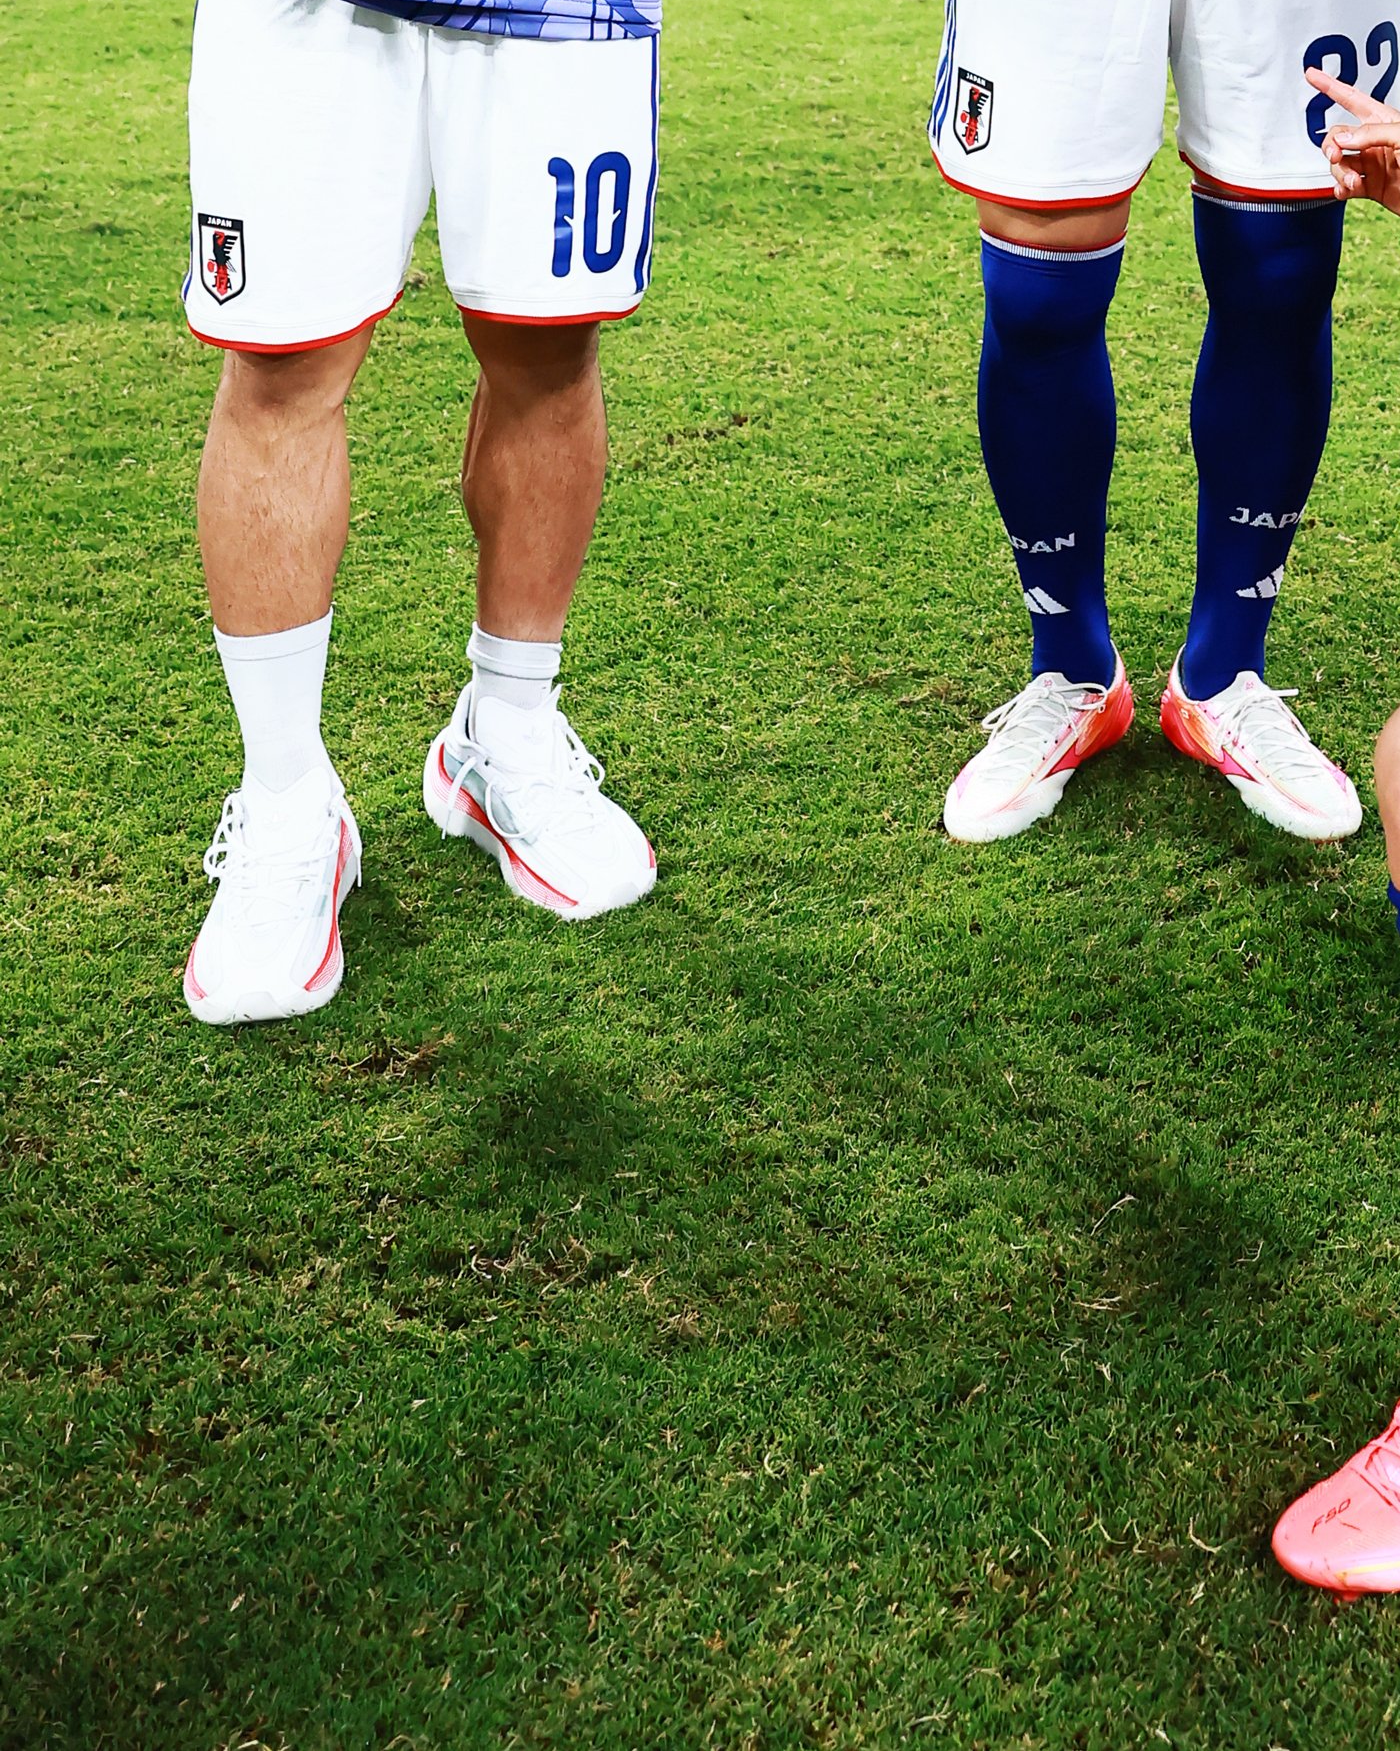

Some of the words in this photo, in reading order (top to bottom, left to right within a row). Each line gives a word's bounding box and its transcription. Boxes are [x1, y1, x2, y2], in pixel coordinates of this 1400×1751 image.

[965, 72, 987, 87] JAPAN
[207, 216, 233, 228] JAPAN
[547, 150, 631, 279] 10
[1228, 506, 1302, 529] JAP
[1009, 531, 1076, 554] PAN
